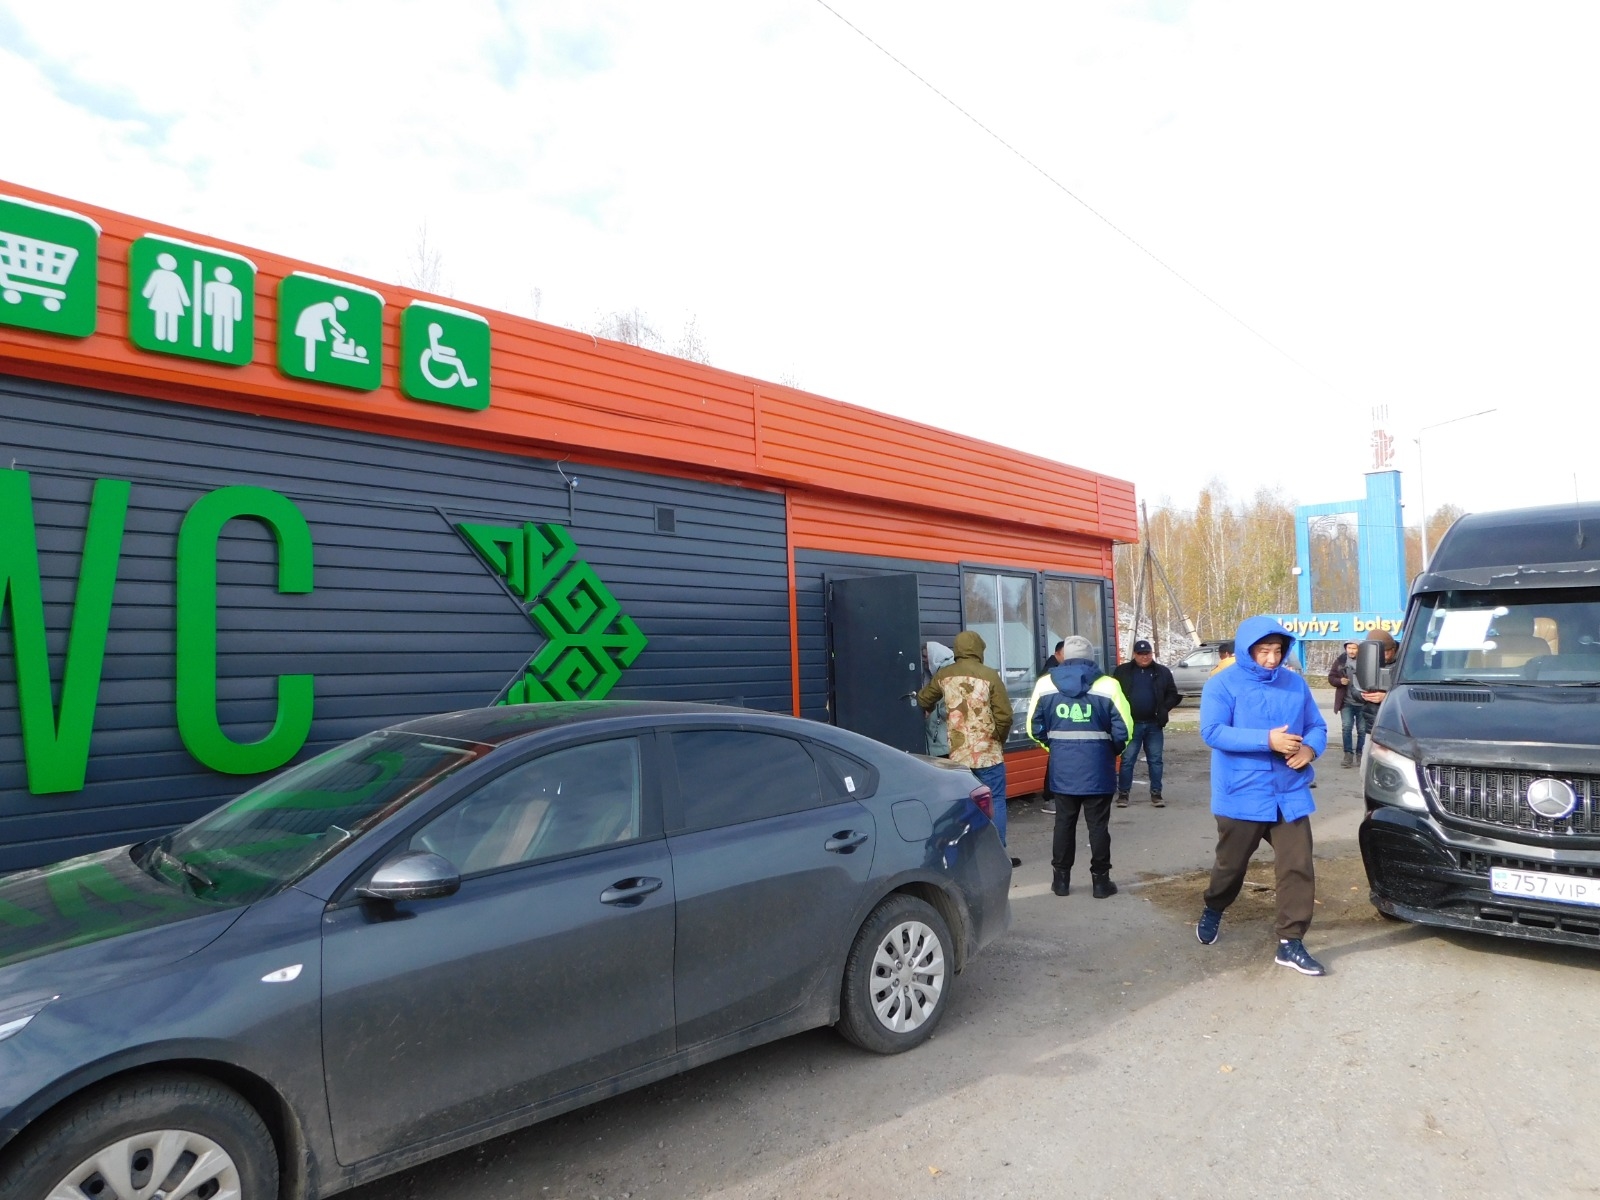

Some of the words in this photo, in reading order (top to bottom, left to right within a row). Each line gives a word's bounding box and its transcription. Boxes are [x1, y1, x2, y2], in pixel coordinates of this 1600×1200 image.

[1056, 703, 1092, 719] QAJ
[1494, 881, 1508, 890] KZ
[1510, 874, 1548, 893] 757
[1555, 882, 1586, 898] VIP
